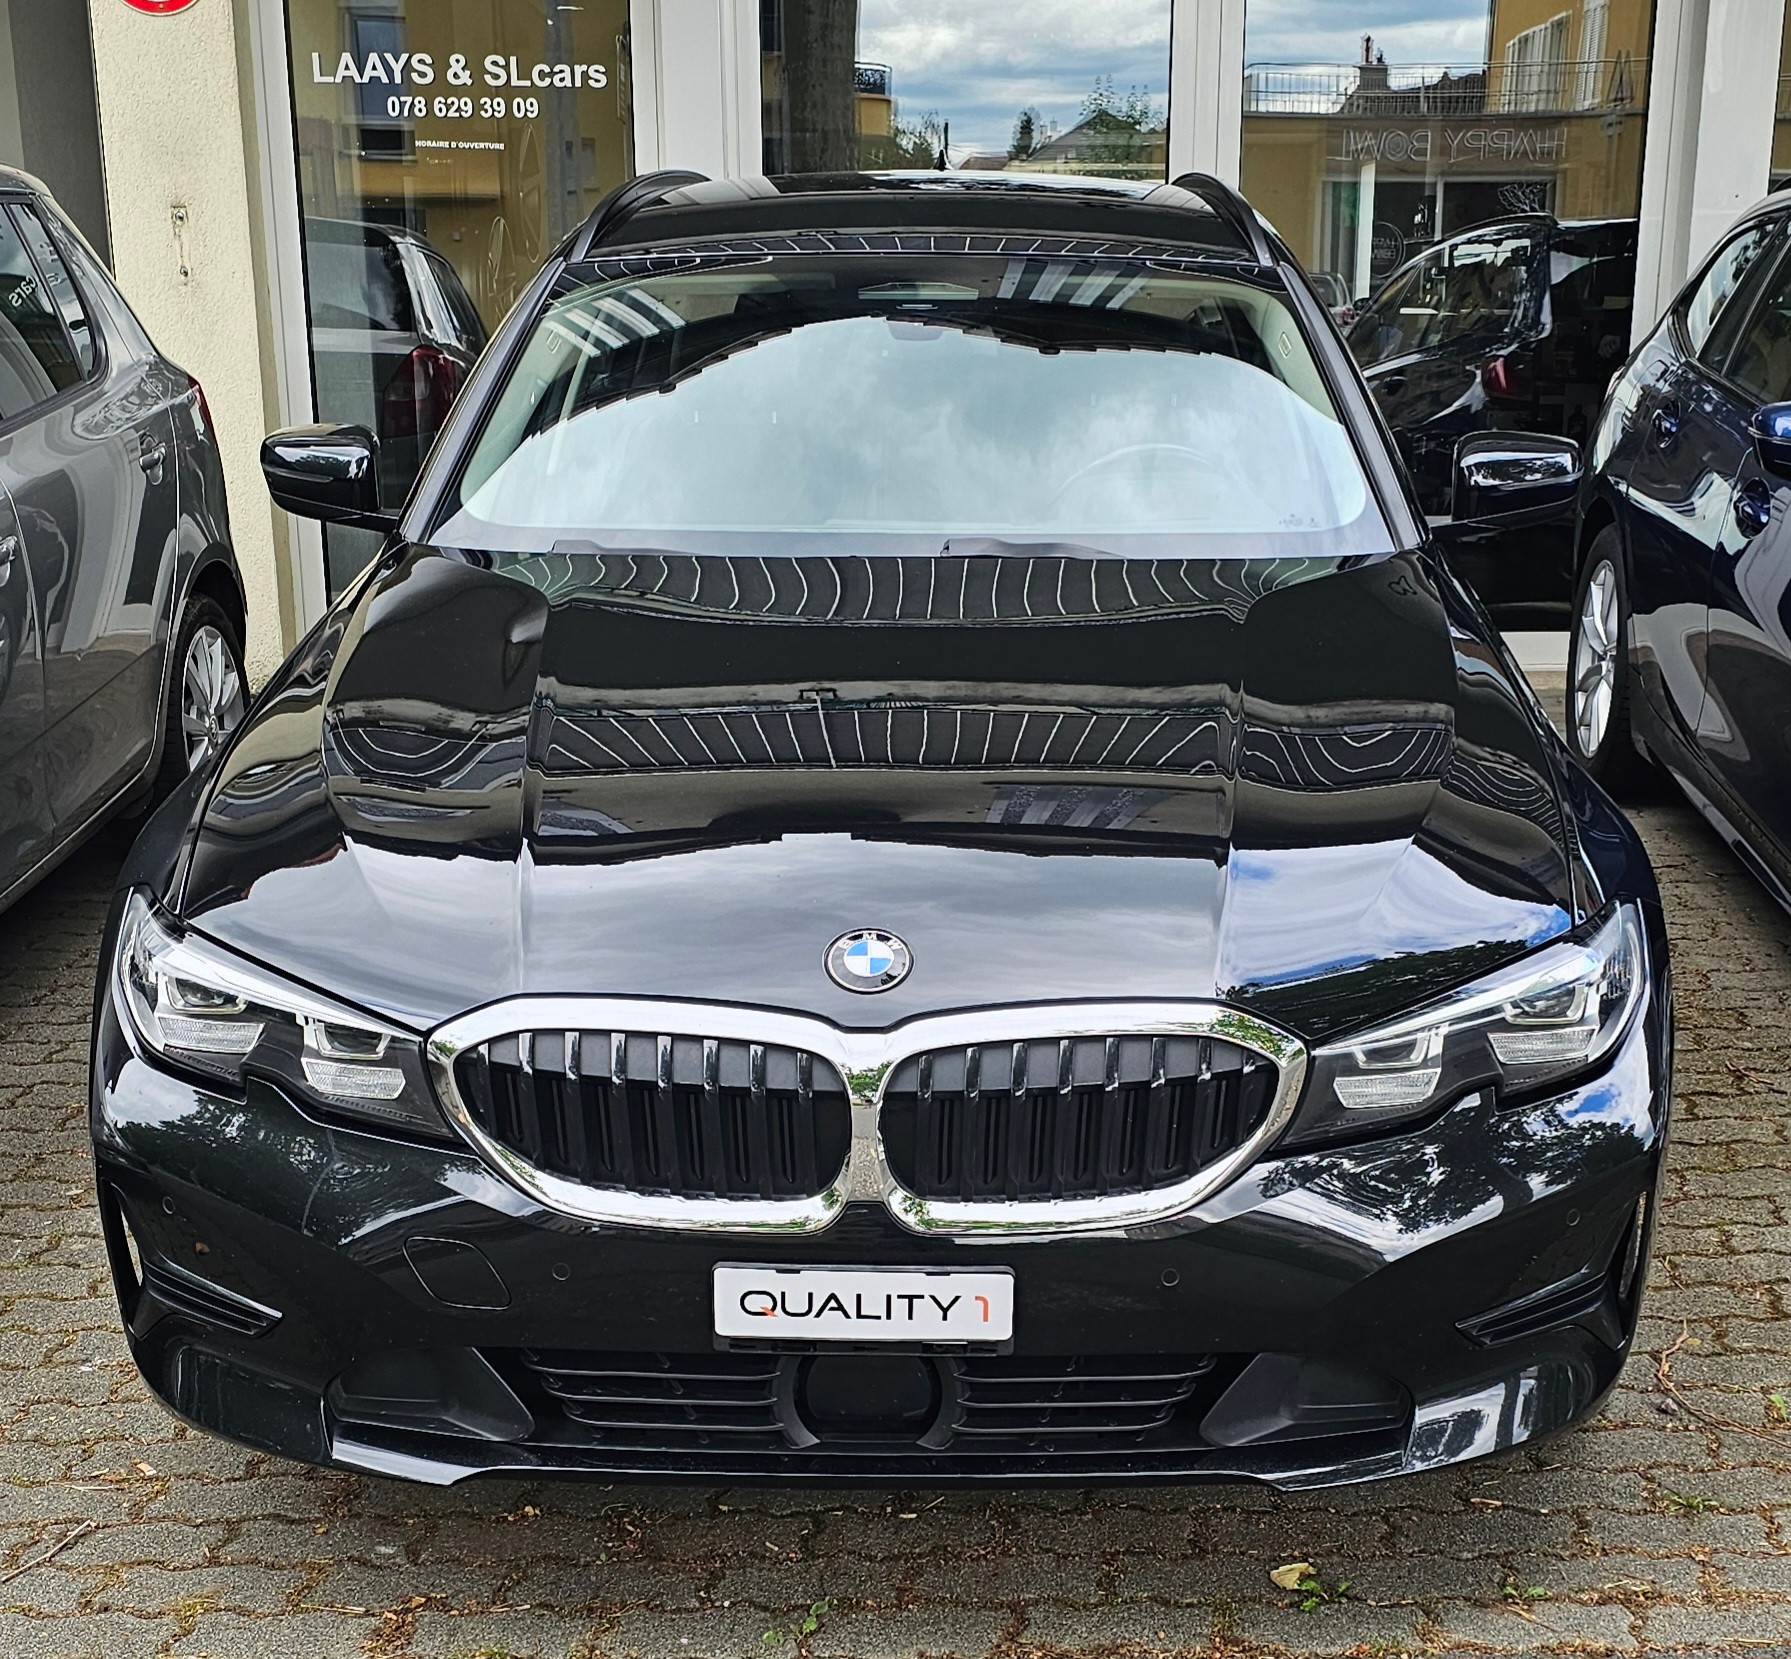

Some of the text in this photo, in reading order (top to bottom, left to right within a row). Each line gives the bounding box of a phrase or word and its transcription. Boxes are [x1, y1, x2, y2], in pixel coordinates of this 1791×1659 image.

[311, 52, 608, 89] LAAYS & SLcars
[387, 96, 540, 119] 078 629 39 09
[415, 140, 505, 151] HORAIRE D'OUVERTURE
[739, 1289, 989, 1323] QUALITY 1
